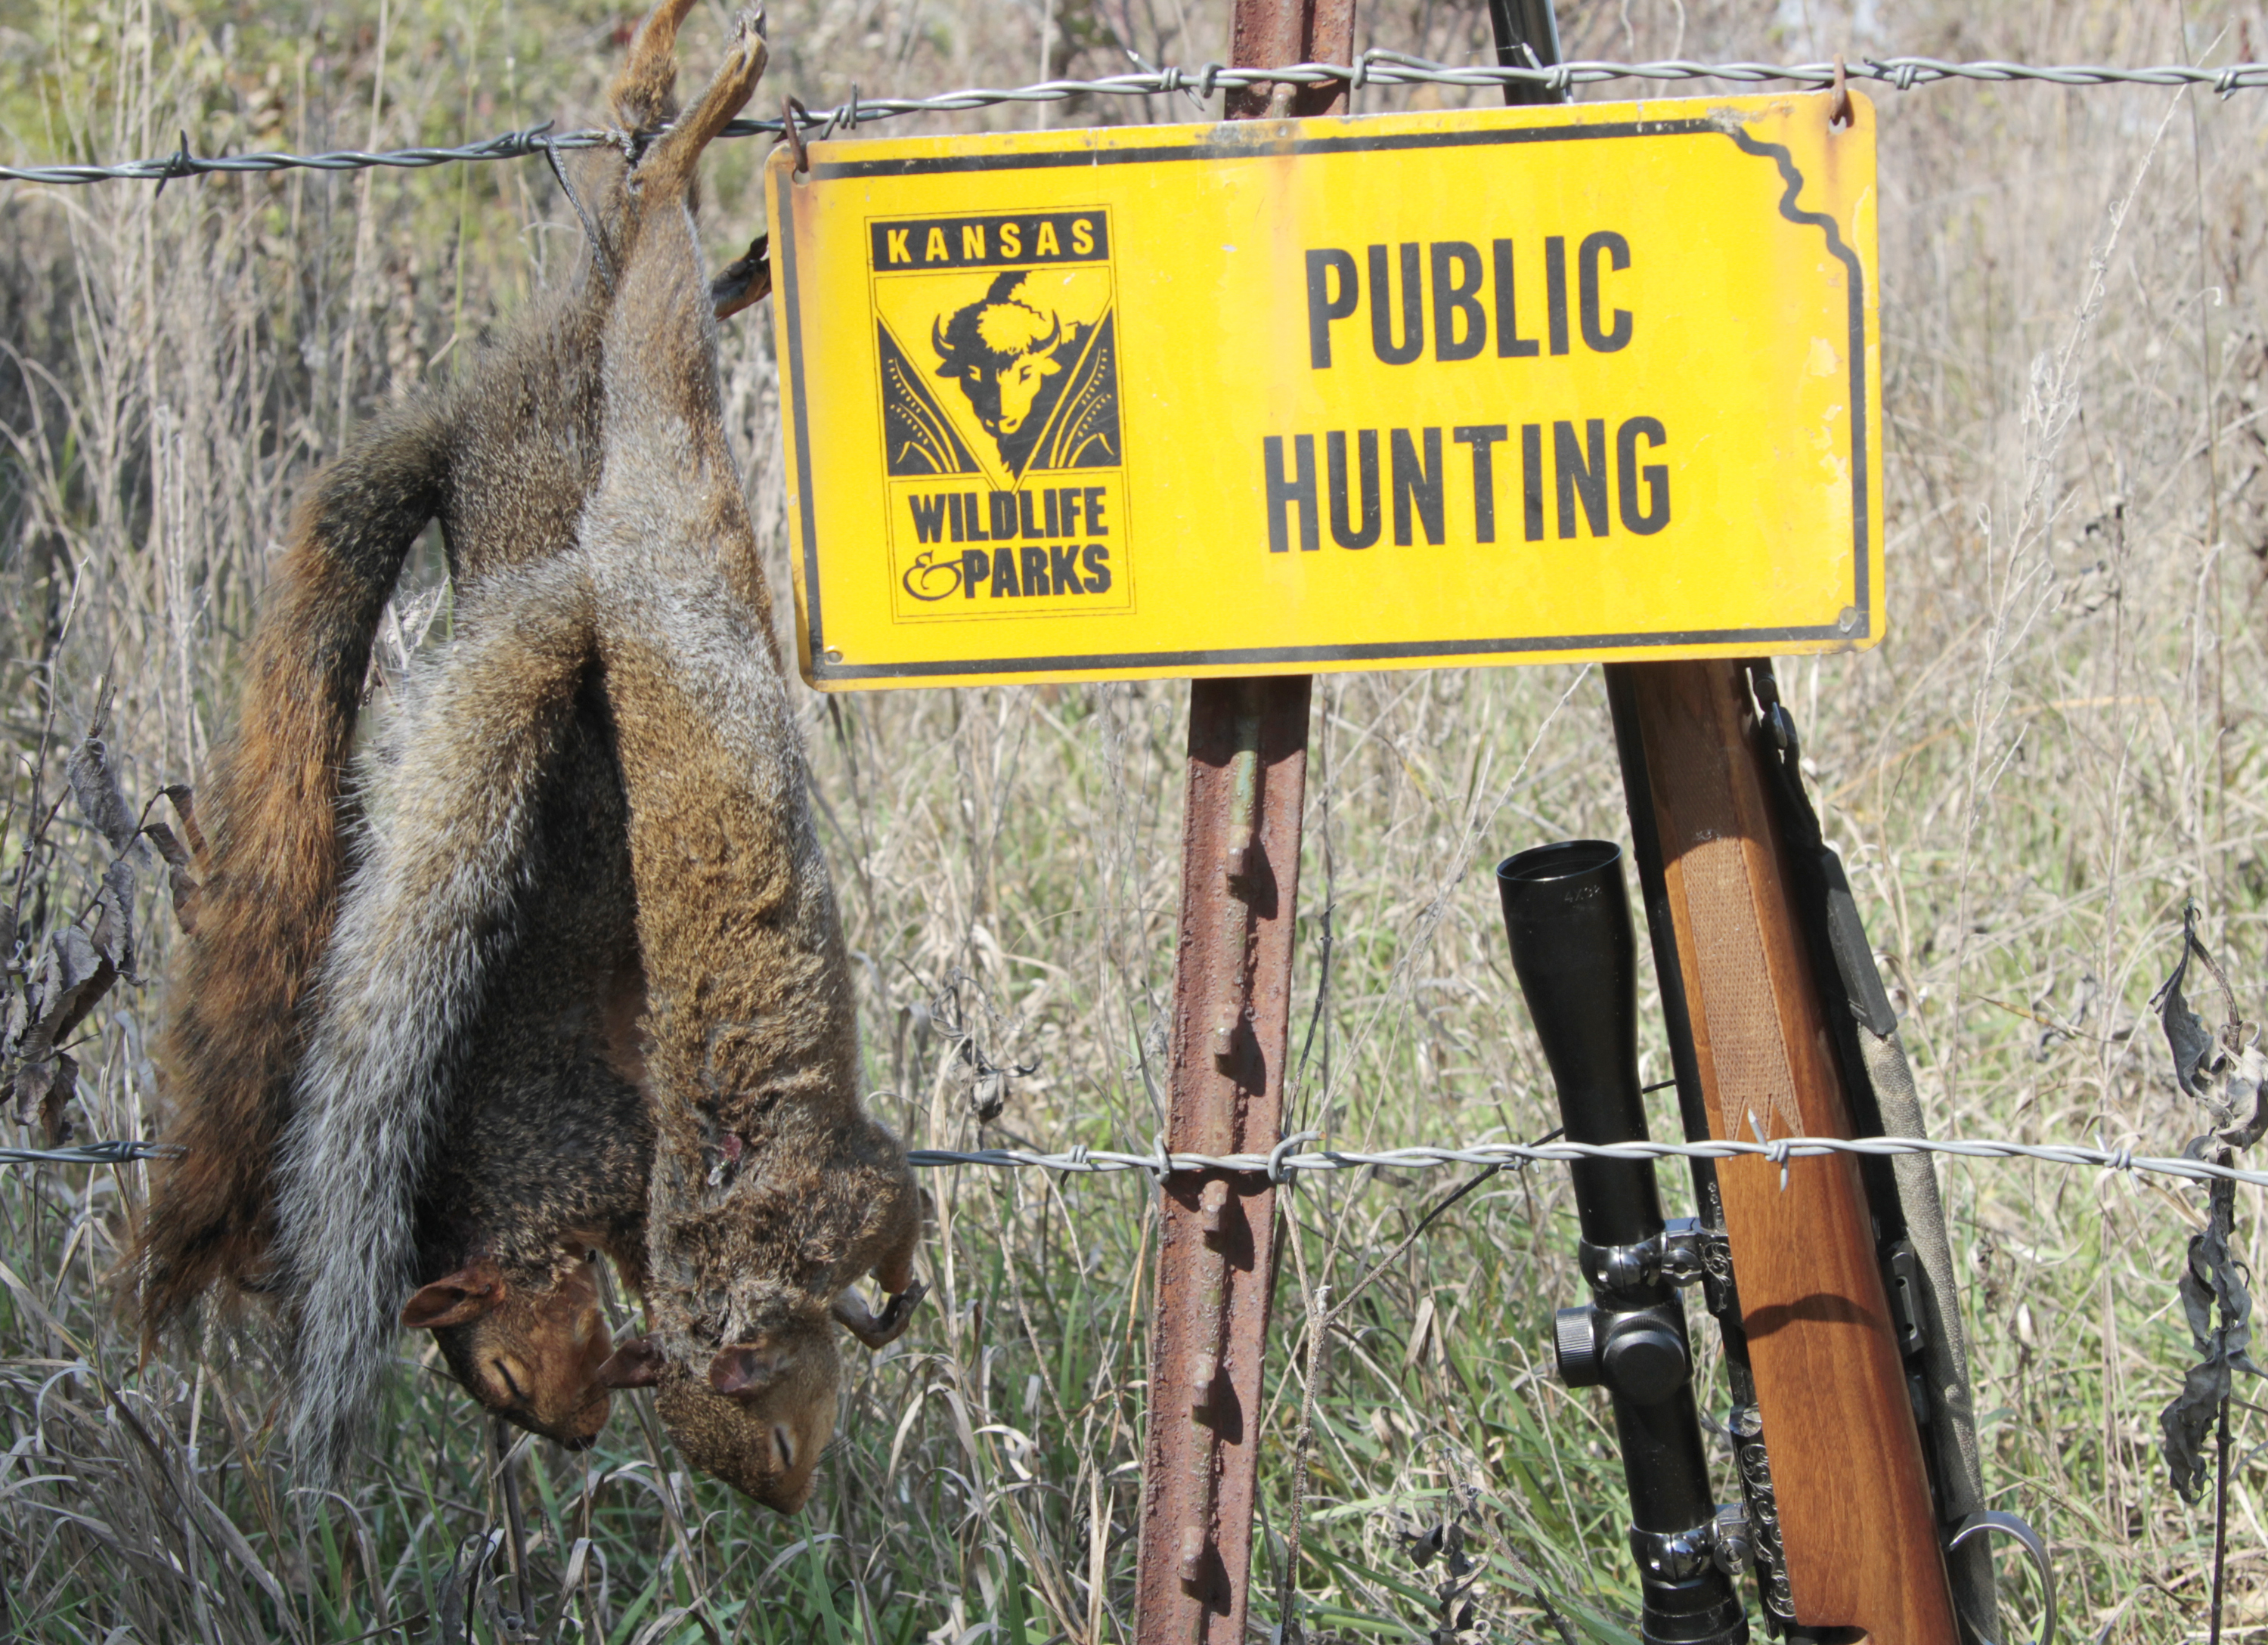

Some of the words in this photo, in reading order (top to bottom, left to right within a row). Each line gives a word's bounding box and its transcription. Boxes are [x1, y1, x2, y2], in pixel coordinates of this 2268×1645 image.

[887, 218, 1095, 264] KANSAS
[1306, 231, 1633, 369] PUBLIC
[909, 487, 1109, 544] WILDLIFE
[1263, 416, 1671, 553] HUNTING
